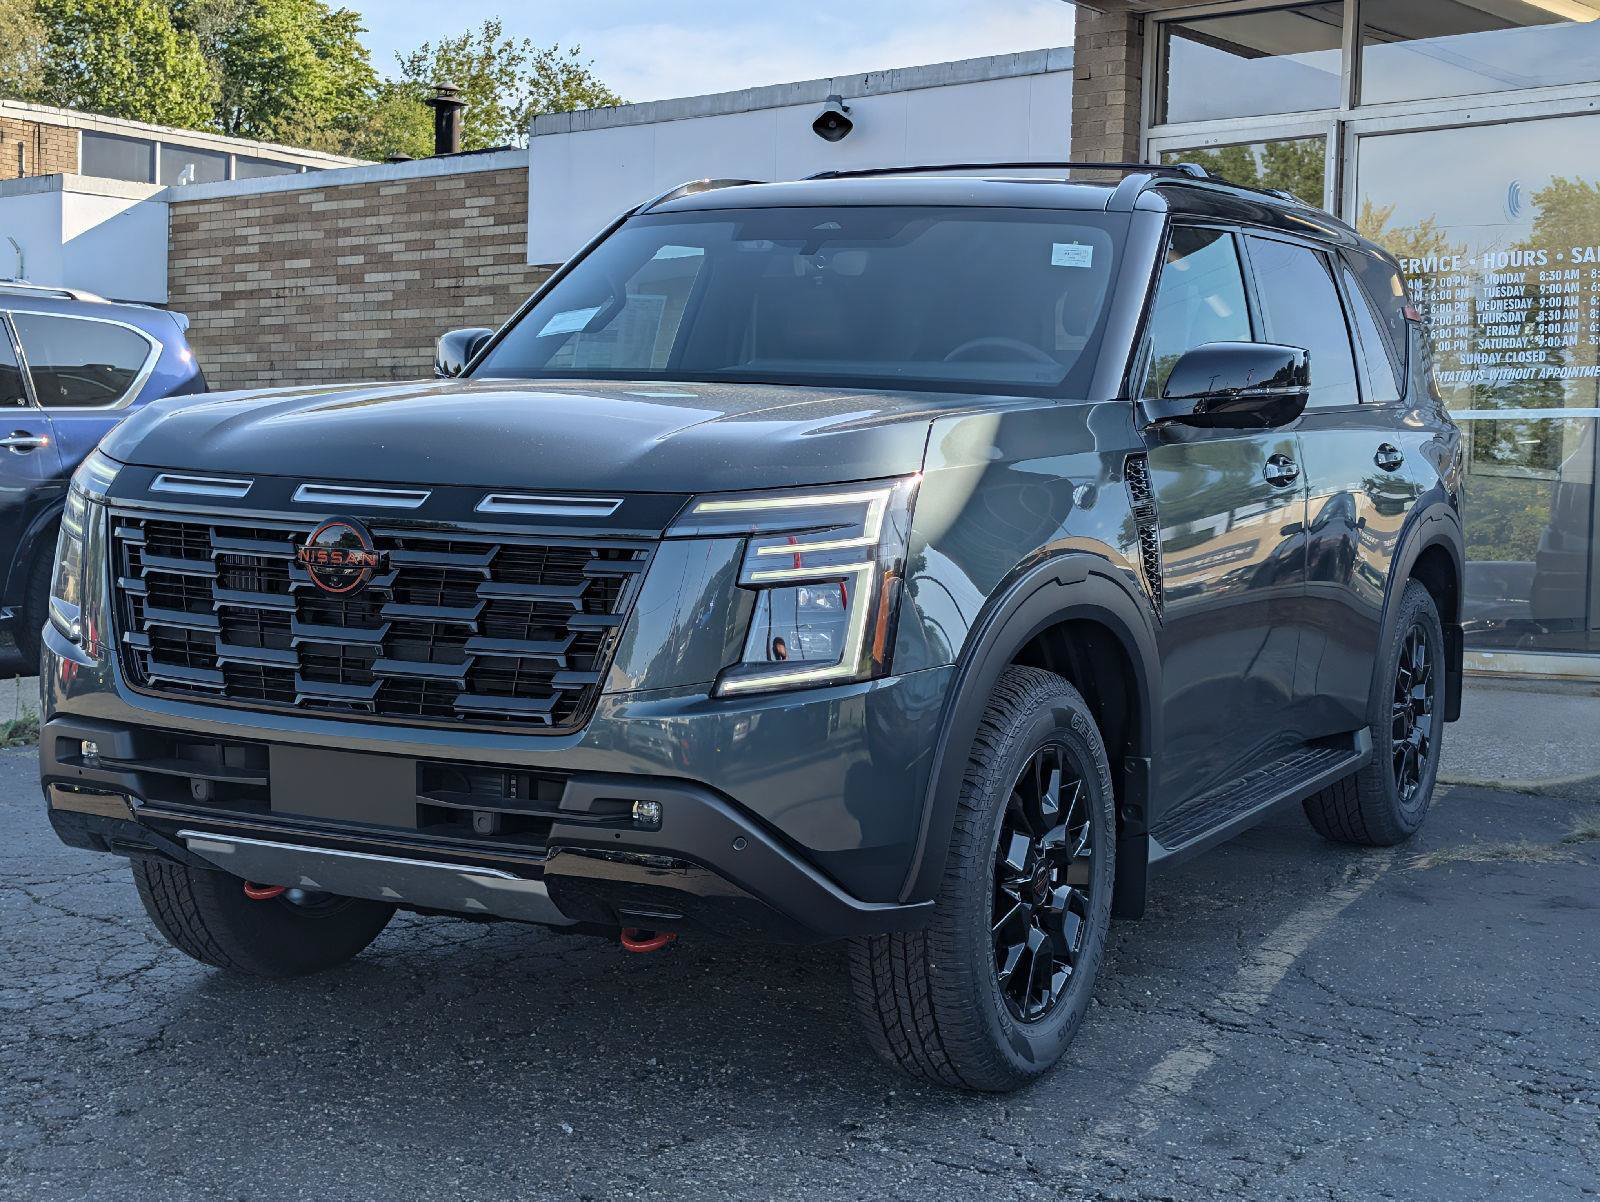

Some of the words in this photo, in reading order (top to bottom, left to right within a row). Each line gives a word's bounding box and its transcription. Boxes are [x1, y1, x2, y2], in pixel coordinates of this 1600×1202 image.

[1400, 255, 1461, 274] ERVICE
[1484, 249, 1548, 269] HOURS
[1484, 272, 1525, 285] MONDAY
[1540, 270, 1562, 281] 8:30
[1564, 269, 1580, 280] AM
[1431, 289, 1452, 301] 6:00
[1455, 288, 1469, 300] PM
[1483, 285, 1525, 298] TUESDAY
[1540, 283, 1562, 295] 9:00
[1564, 282, 1580, 293] AM
[1431, 302, 1452, 314] 6:00
[1455, 301, 1469, 312] PM
[1475, 298, 1533, 311] WEDNESDAY
[1540, 296, 1562, 308] 9:00
[1564, 295, 1579, 307] AM
[1431, 315, 1452, 326] 7:00
[1455, 314, 1469, 325] PM
[1476, 311, 1527, 324] THURSDAY
[1538, 309, 1561, 322] 8:30
[1562, 308, 1579, 320] AM
[1431, 328, 1452, 340] 6:00
[1455, 327, 1469, 338] PM
[1486, 324, 1521, 337] FRIDAY
[1539, 322, 1561, 335] 9:00
[1562, 321, 1579, 333] AM
[1435, 341, 1451, 352] :00
[1454, 339, 1468, 351] PM
[1478, 337, 1528, 350] SATURDAY
[1539, 335, 1561, 347] 9:00
[1561, 334, 1578, 346] AM
[1460, 352, 1502, 365] SUNDAY
[1505, 350, 1547, 363] CLOSED
[1490, 367, 1537, 381] WITHOUT
[299, 549, 377, 566] NISSAN
